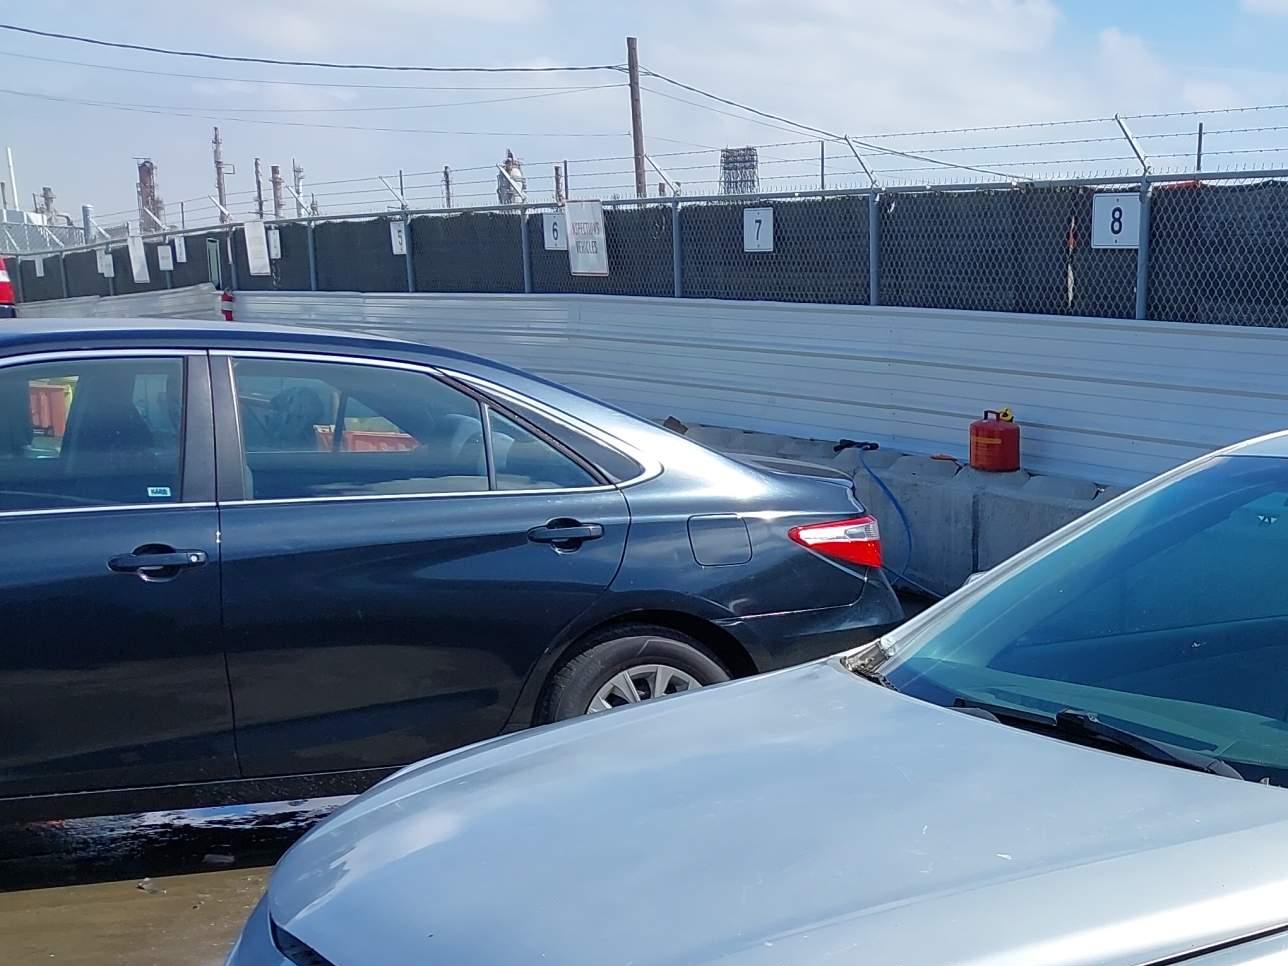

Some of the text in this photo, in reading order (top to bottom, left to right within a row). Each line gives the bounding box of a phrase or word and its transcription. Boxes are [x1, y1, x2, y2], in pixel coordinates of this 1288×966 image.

[570, 222, 600, 236] NSPECTIONS
[754, 219, 762, 241] 7
[1110, 206, 1123, 235] 8
[397, 229, 403, 246] 5
[552, 222, 559, 241] 6
